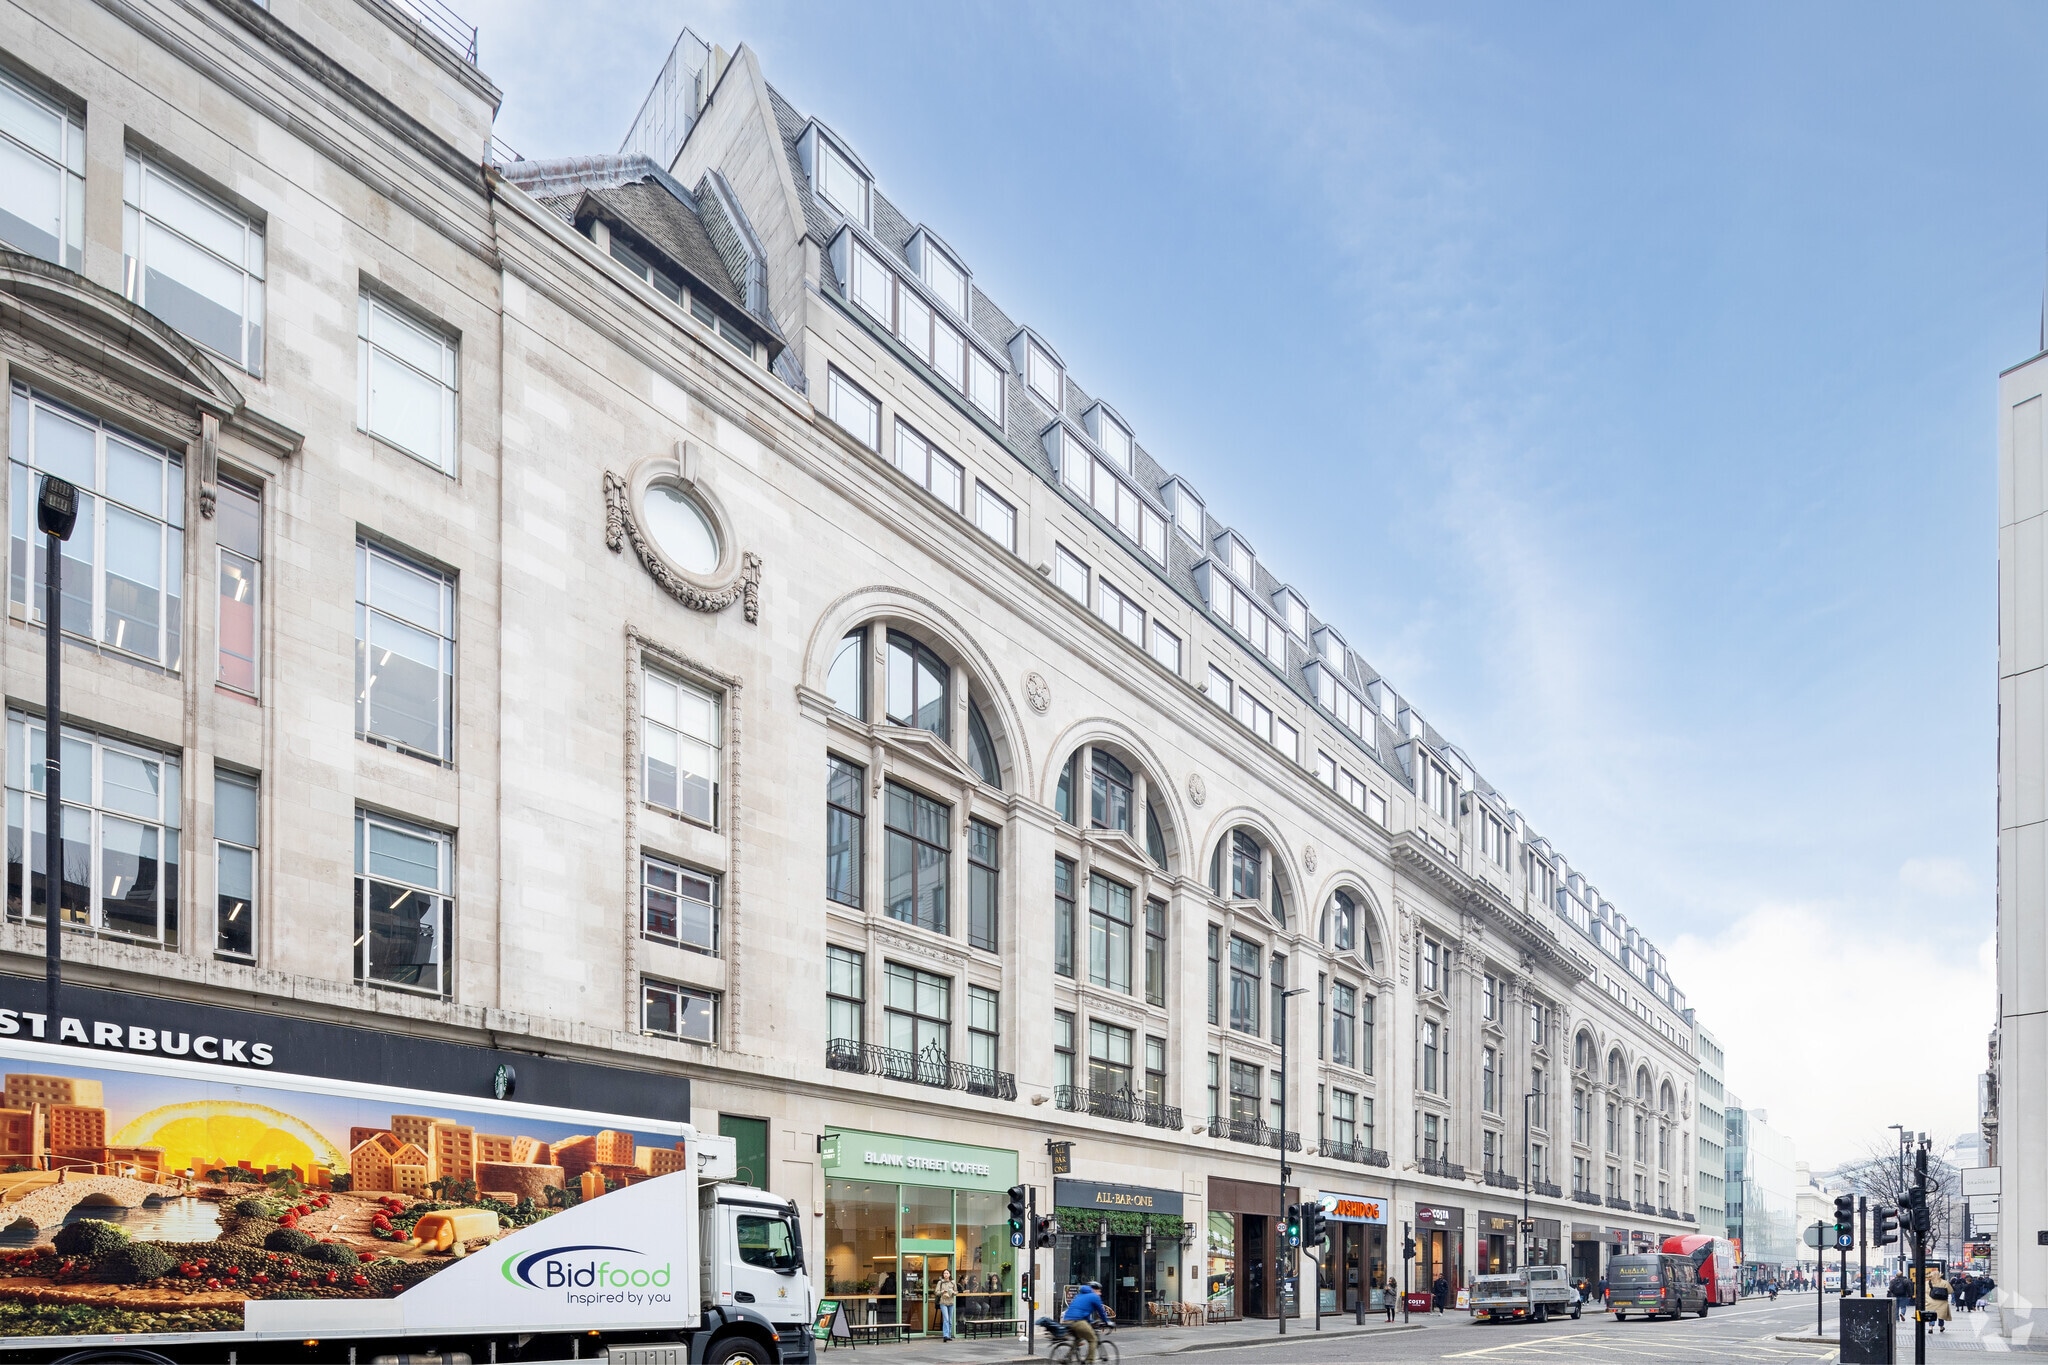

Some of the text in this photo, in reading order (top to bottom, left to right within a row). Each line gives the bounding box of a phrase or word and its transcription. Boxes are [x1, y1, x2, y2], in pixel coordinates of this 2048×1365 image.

[0, 1008, 274, 1066] STARBUCKS
[864, 1151, 990, 1176] BLANK STREET COFFEE
[1054, 1156, 1067, 1164] BAR
[1432, 1209, 1450, 1220] COSTA
[547, 1260, 670, 1288] Bidfood
[567, 1291, 671, 1306] Inspired by you
